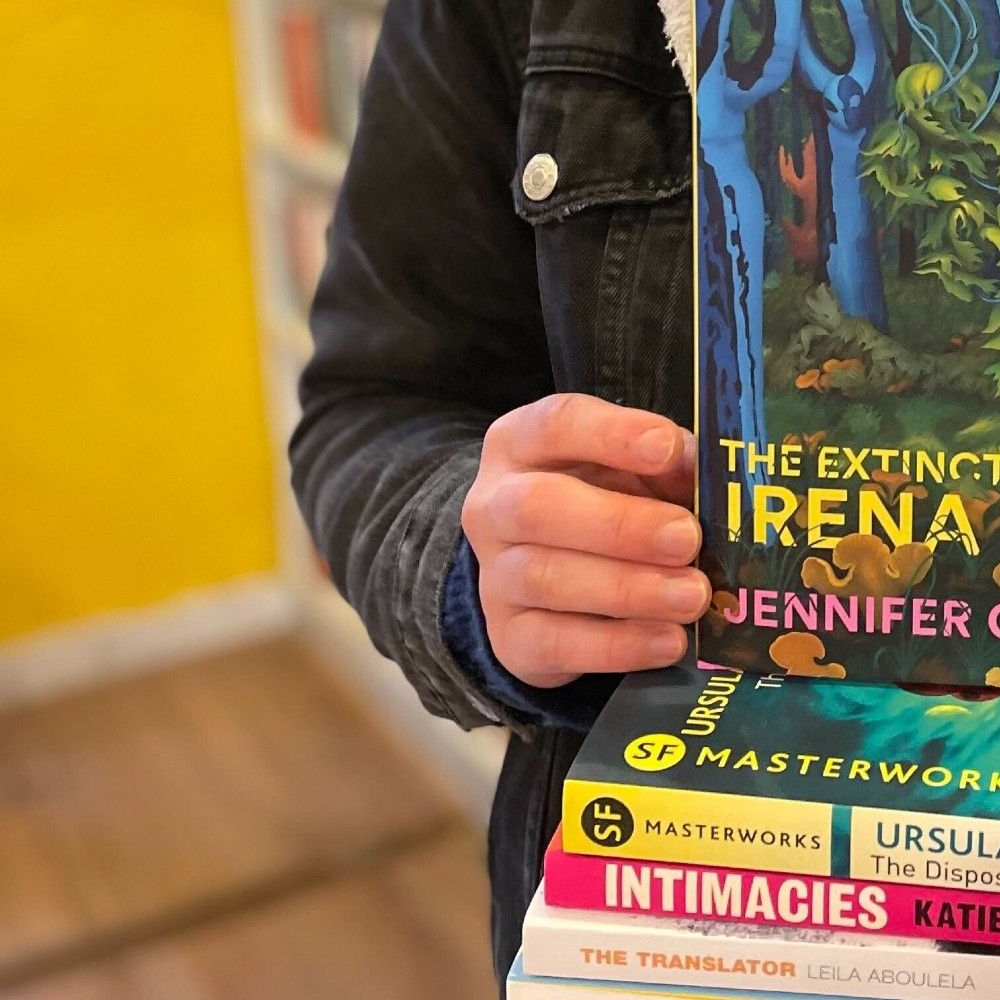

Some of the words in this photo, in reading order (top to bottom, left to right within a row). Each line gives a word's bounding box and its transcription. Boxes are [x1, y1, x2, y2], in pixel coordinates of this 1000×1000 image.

[719, 438, 803, 477] THE
[727, 481, 982, 557] IRENA
[724, 588, 972, 639] JENNIFER
[632, 742, 679, 762] SF
[595, 803, 622, 842] SF
[645, 819, 821, 850] MASTERWORKS
[871, 855, 915, 879] The
[604, 864, 888, 931] INTIMACIES
[580, 948, 628, 966] THE
[639, 952, 796, 977] TRANSLATOR
[808, 965, 861, 984] LEILA
[867, 969, 976, 991] ABOULELA
